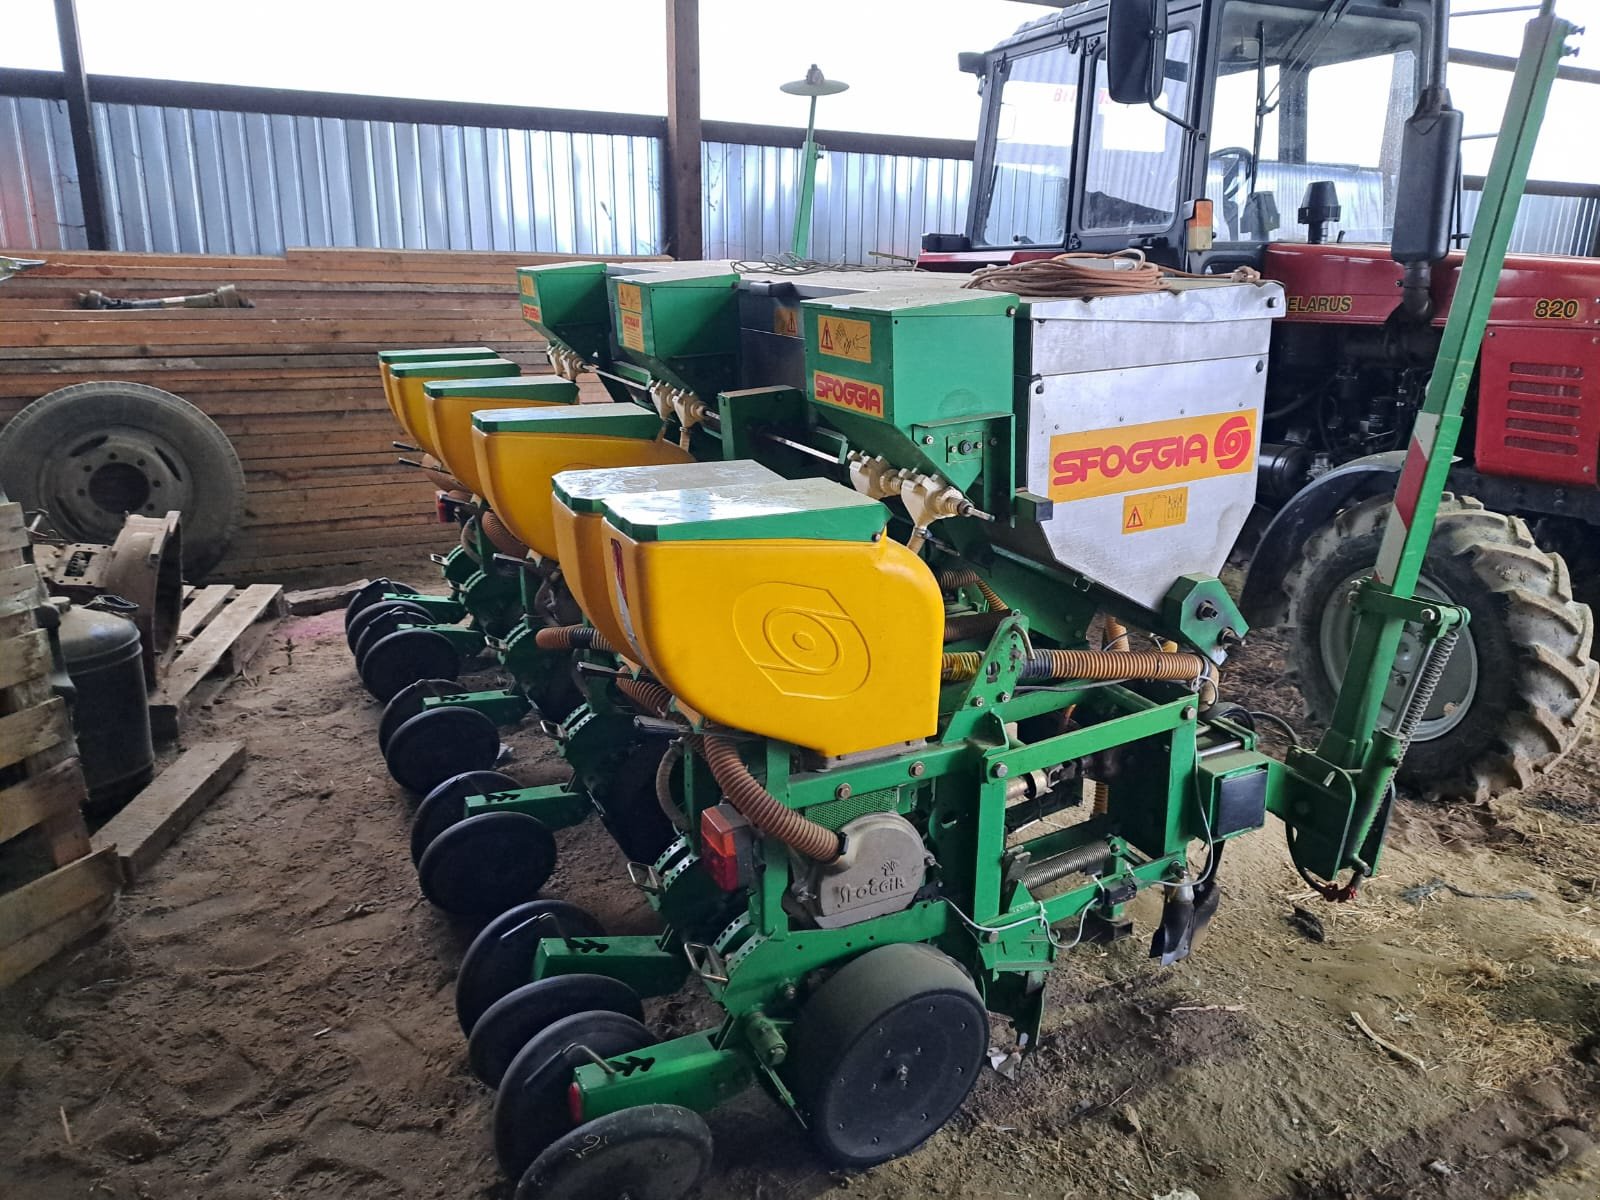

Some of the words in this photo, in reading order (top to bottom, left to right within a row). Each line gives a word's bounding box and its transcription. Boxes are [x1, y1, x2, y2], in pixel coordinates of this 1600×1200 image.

[1286, 295, 1353, 313] ELARUS
[1534, 298, 1579, 319] 820
[815, 374, 881, 414] SFOGGIA
[1052, 433, 1209, 486] SFOGGIA
